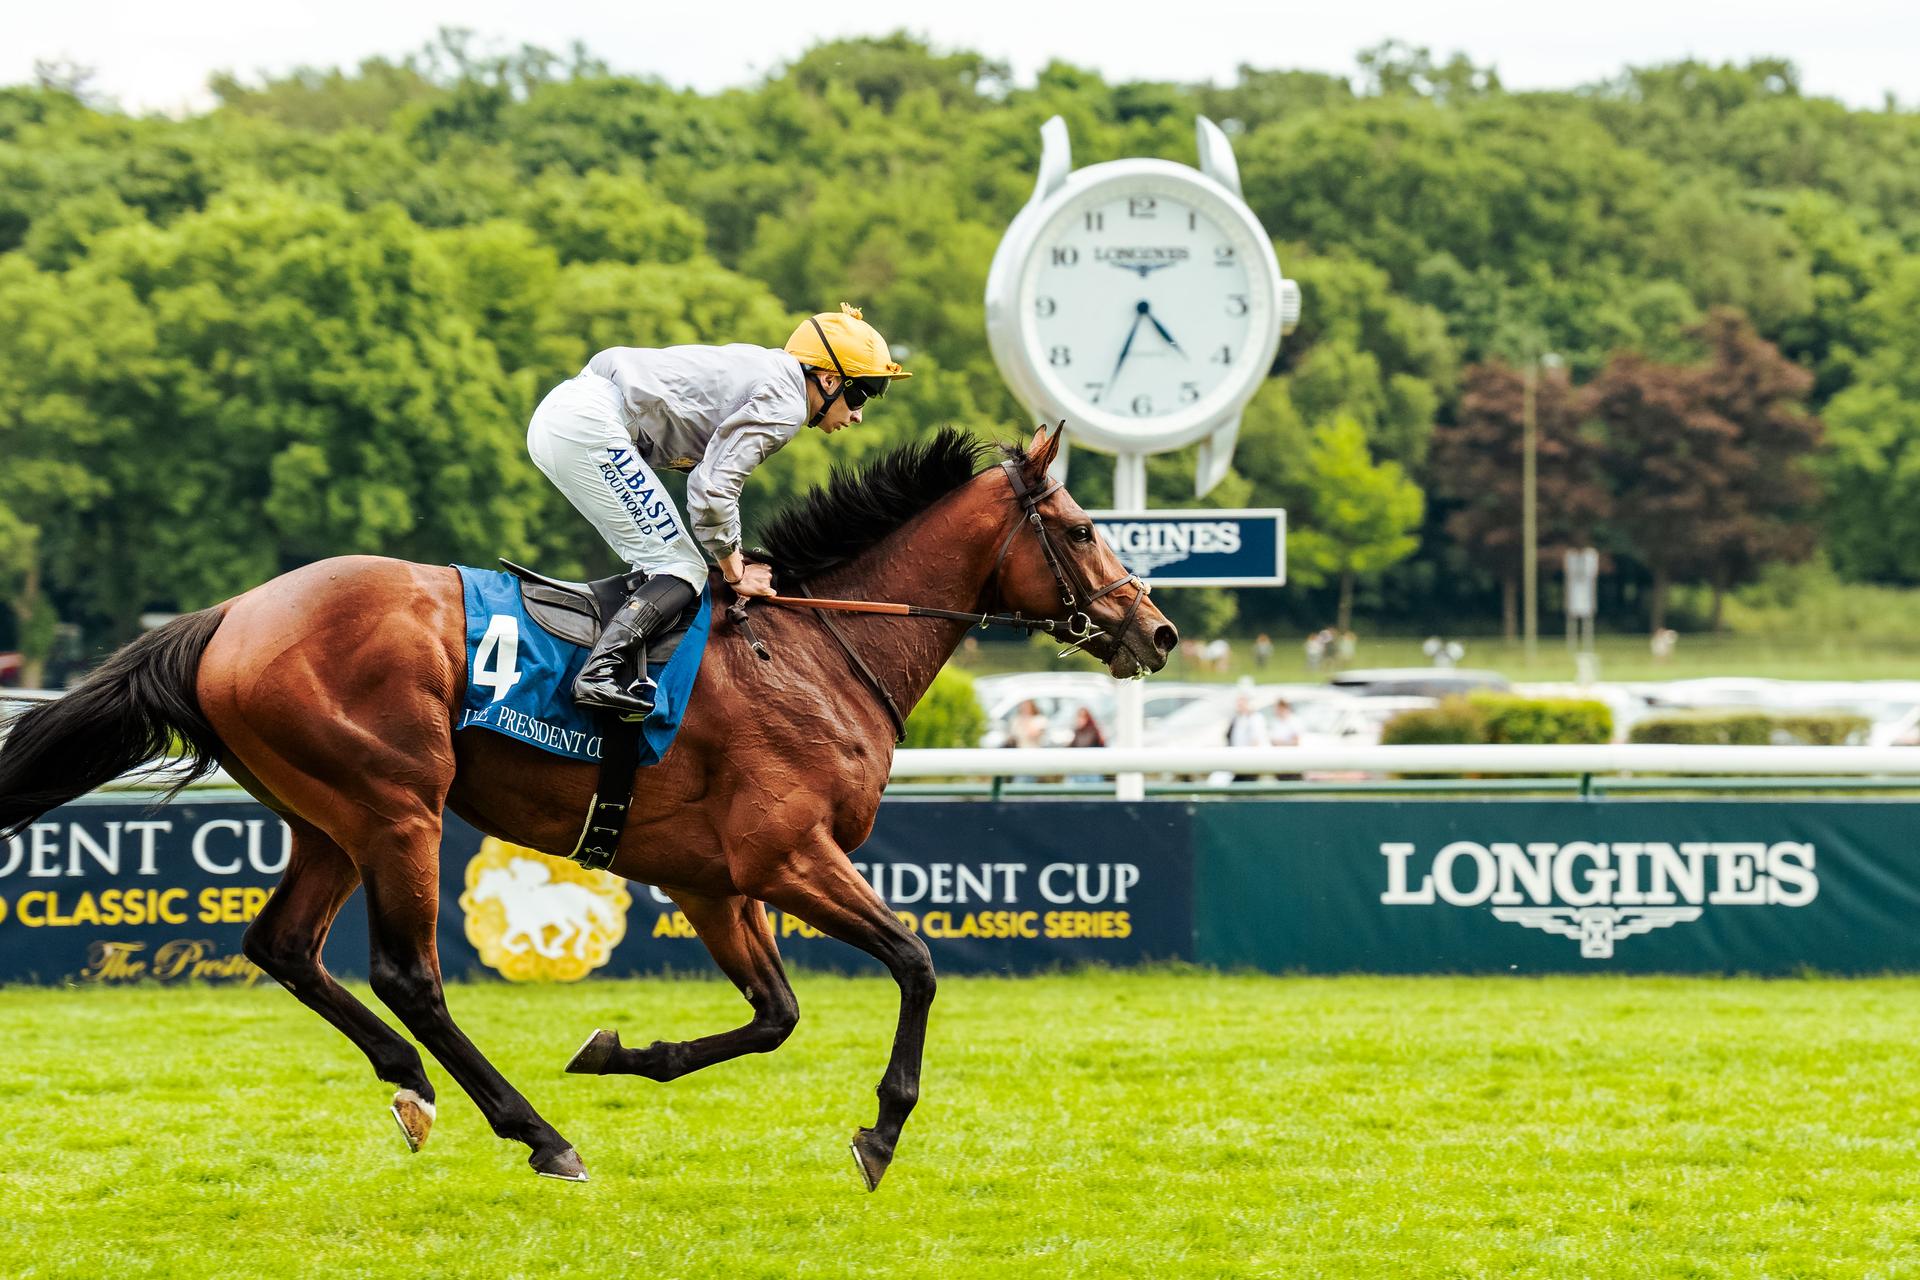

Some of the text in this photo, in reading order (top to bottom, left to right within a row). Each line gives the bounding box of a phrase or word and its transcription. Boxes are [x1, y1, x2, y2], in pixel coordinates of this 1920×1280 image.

[1129, 196, 1157, 218] 12
[1084, 211, 1104, 231] 11
[1188, 211, 1197, 231] 1
[1051, 246, 1079, 267] 10
[1094, 246, 1189, 261] LONGINES
[1215, 246, 1235, 267] 2
[1035, 297, 1057, 318] 9
[1226, 294, 1249, 317] 3
[1049, 347, 1071, 367] 8
[1212, 346, 1232, 366] 4
[1085, 382, 1104, 404] 7
[1179, 381, 1200, 403] 5
[1131, 394, 1153, 418] 6
[599, 463, 653, 536] EQUIWORLD
[606, 447, 680, 544] ALBASTI
[1095, 521, 1242, 554] NGINES
[472, 614, 522, 703] 4
[496, 705, 587, 753] PRESIDENT
[586, 735, 604, 759] CU
[191, 819, 293, 875] CU
[855, 862, 1141, 904] IDENT CUP
[1380, 841, 1819, 906] LONGINES
[16, 888, 189, 928] CLASSIC
[198, 886, 277, 924] SER
[922, 911, 1039, 939] CLASSIC
[1044, 911, 1132, 939] SERIES
